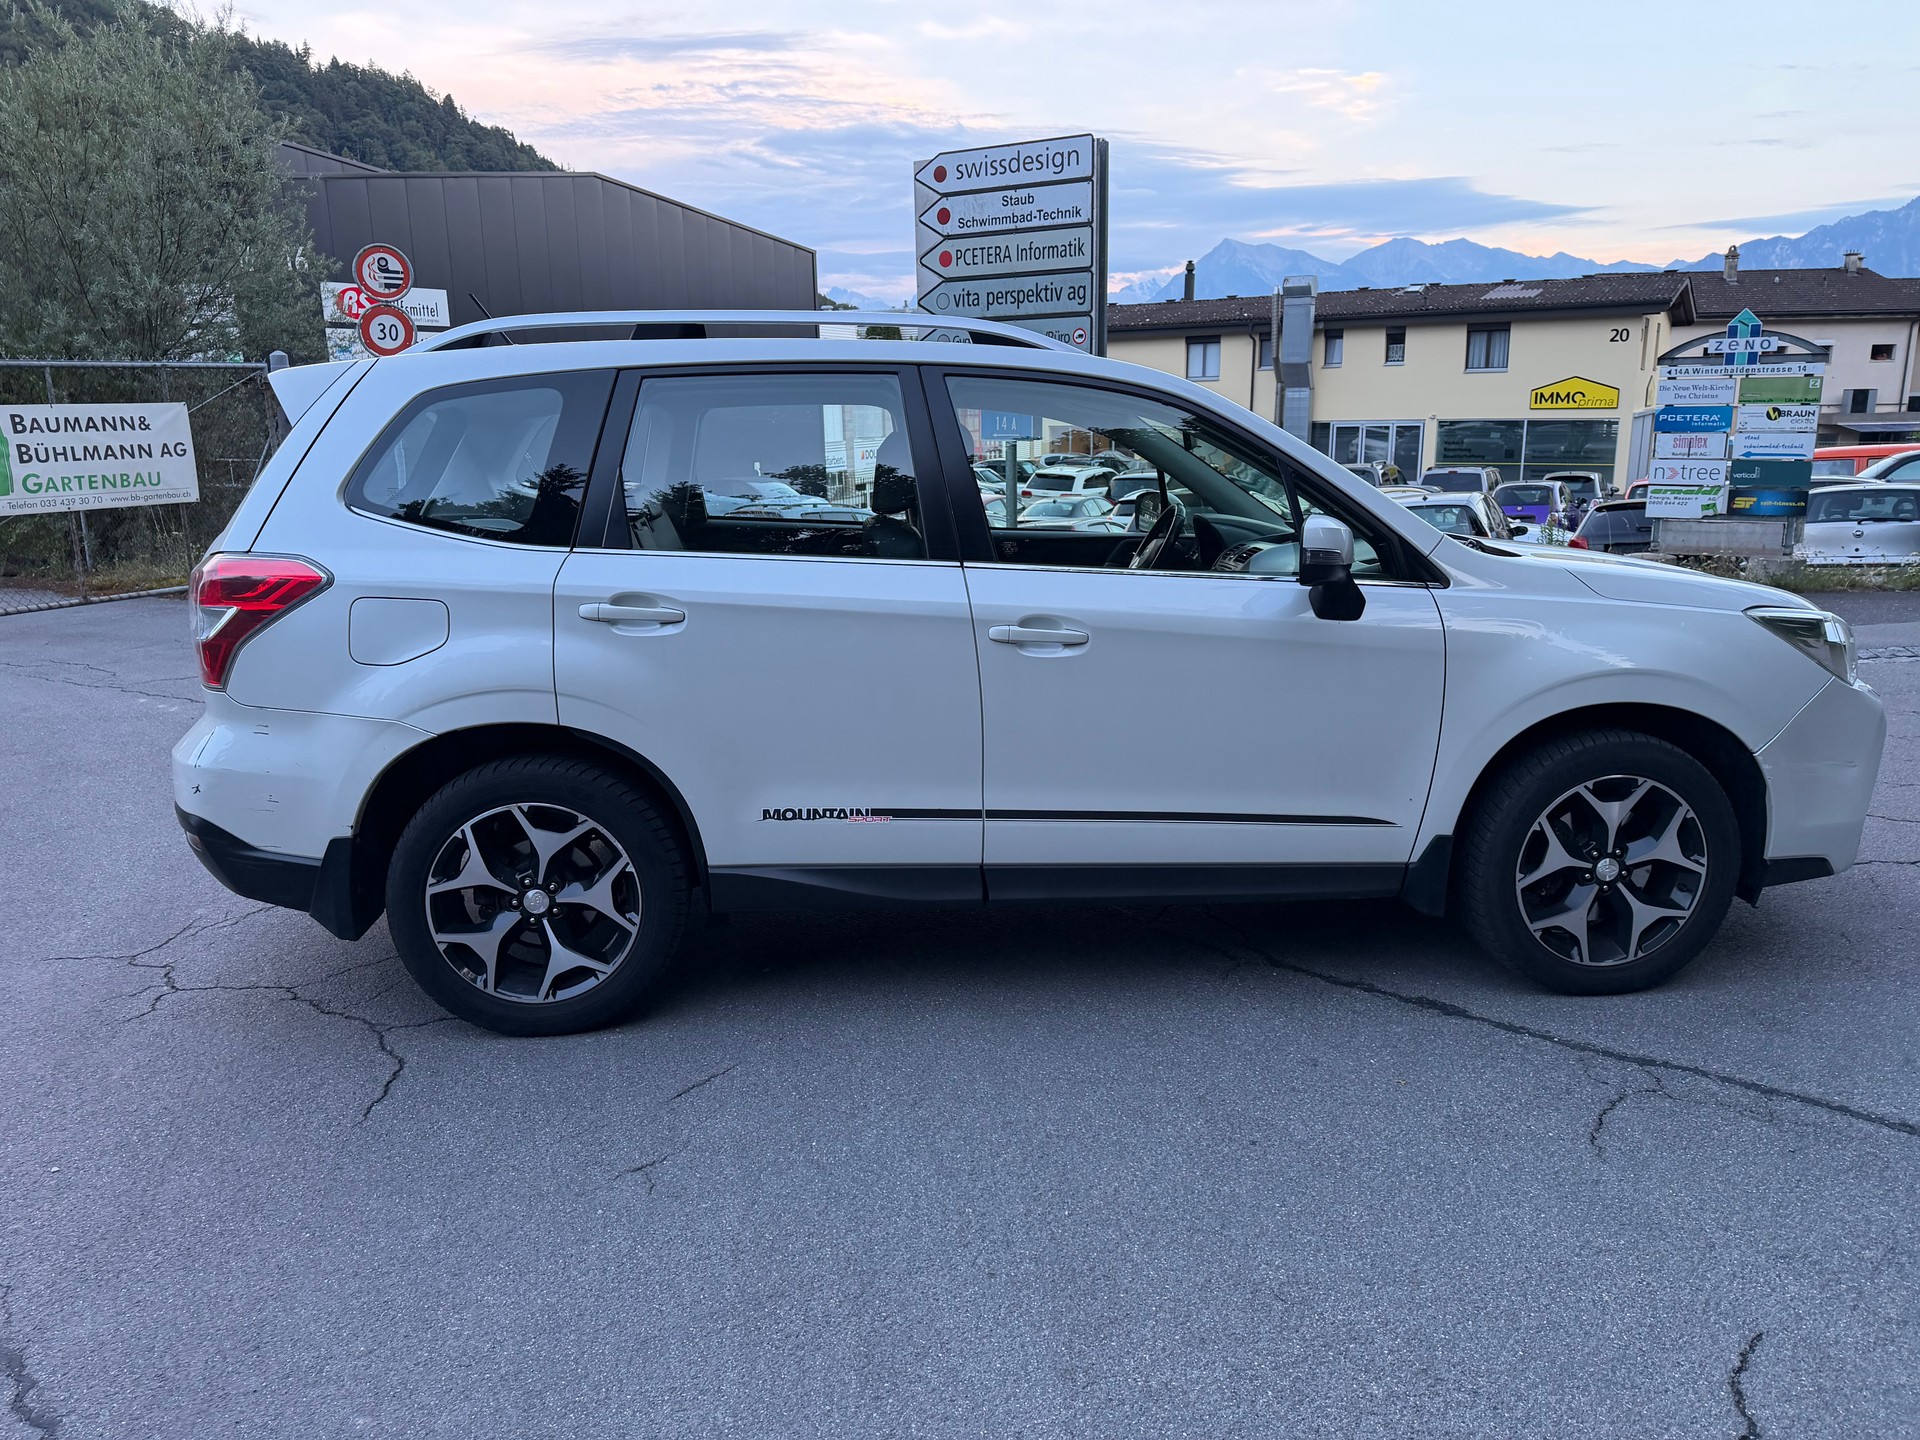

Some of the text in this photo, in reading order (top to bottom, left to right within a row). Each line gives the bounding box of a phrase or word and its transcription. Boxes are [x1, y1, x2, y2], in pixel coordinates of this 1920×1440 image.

[955, 146, 1080, 180] swissdesign
[1001, 193, 1034, 207] Staub
[957, 205, 1082, 229] Schwimmbad-Technik
[955, 236, 1086, 267] PCETERA Informatik
[953, 281, 1087, 311] vita perspektiv ag
[377, 322, 399, 342] 30
[1609, 327, 1630, 342] 20
[1692, 365, 1793, 375] Winterhaldenstrasse
[1797, 365, 1807, 373] 14
[1577, 396, 1615, 408] prima
[995, 416, 1017, 430] 14 A
[1780, 409, 1816, 418] BRAUN
[9, 413, 152, 435] BAUMANN&
[1673, 435, 1708, 449] simplex
[15, 441, 188, 465] BÜHLMANN AG
[21, 471, 162, 495] GARTENBAU
[7, 491, 192, 510] Telefon 033 439 30 70 www.bb-gartenbau.ch
[761, 807, 870, 821] MOUNTAIN
